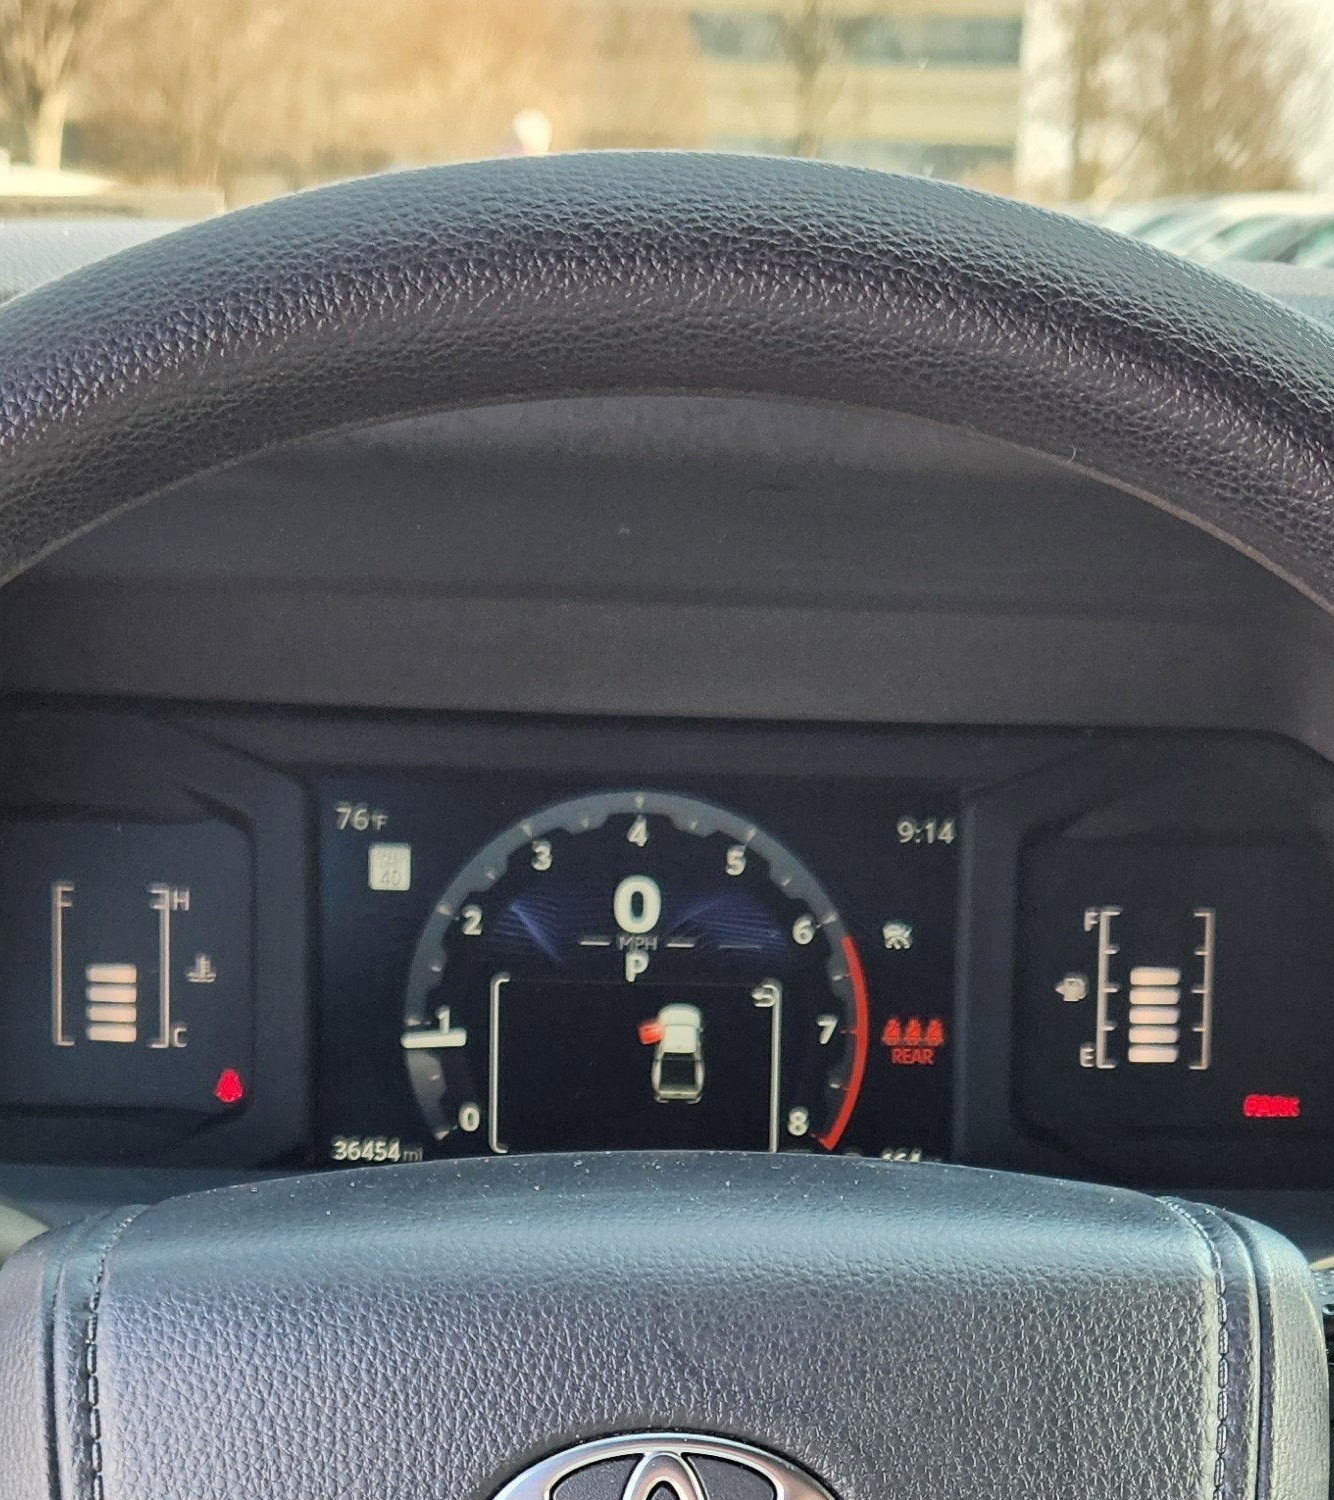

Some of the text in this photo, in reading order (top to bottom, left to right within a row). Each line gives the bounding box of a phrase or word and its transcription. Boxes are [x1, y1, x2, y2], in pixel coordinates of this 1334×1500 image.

[627, 815, 648, 847] 4
[897, 818, 956, 846] 9:14
[531, 840, 552, 871] 3
[725, 845, 747, 876] 5
[172, 887, 190, 910] H
[614, 875, 662, 934] 0
[463, 904, 483, 936] 2
[792, 914, 816, 946] 6
[1084, 909, 1099, 931] F
[618, 936, 659, 951] MPH
[625, 950, 650, 982] P
[437, 1006, 452, 1034] 1
[817, 1014, 838, 1045] 7
[174, 1025, 188, 1047] C
[890, 1048, 934, 1065] REAR
[1080, 1045, 1096, 1067] E
[458, 1102, 480, 1132] 0
[787, 1107, 809, 1136] 8
[332, 1137, 423, 1162] 36454 mi
